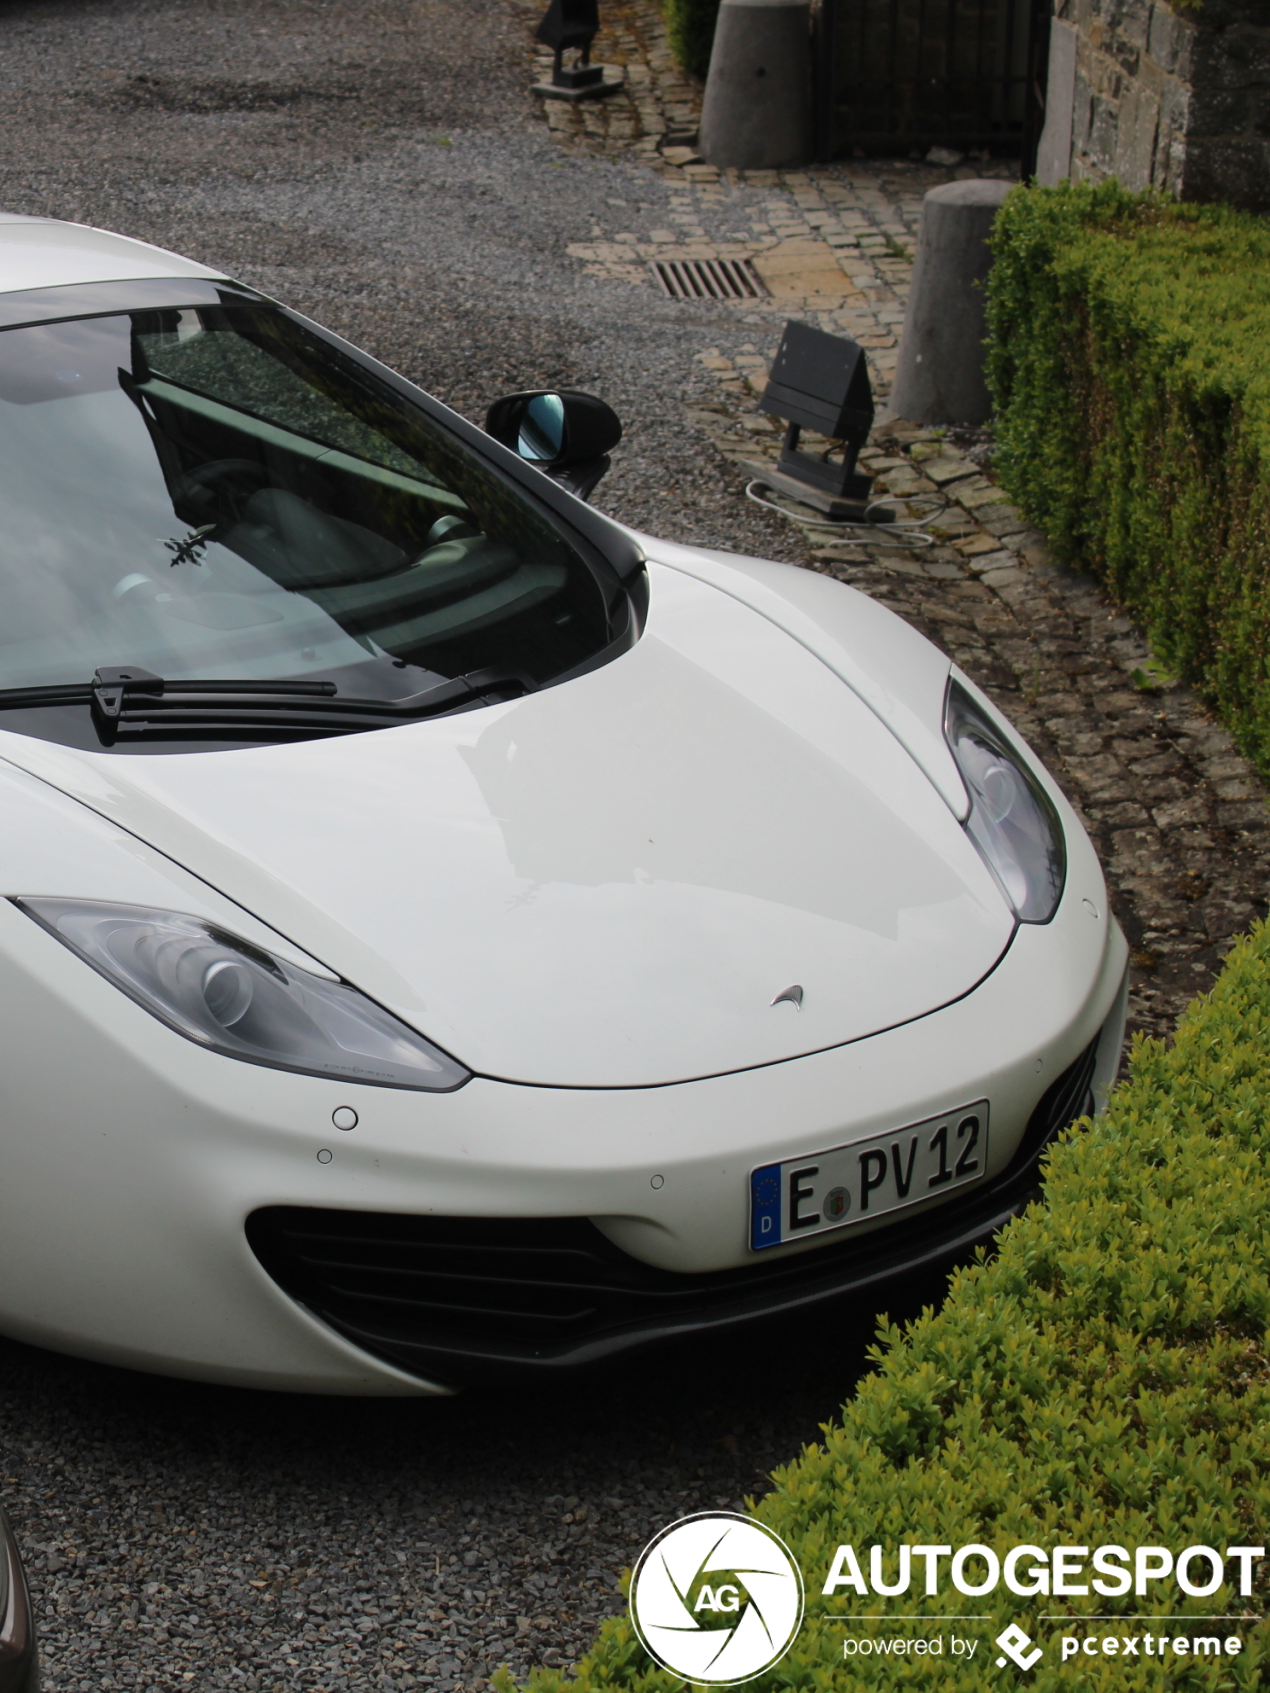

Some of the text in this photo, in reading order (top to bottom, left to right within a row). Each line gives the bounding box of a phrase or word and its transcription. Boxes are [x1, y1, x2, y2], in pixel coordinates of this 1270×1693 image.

[790, 1114, 980, 1230] E PV 12
[761, 1216, 772, 1233] D
